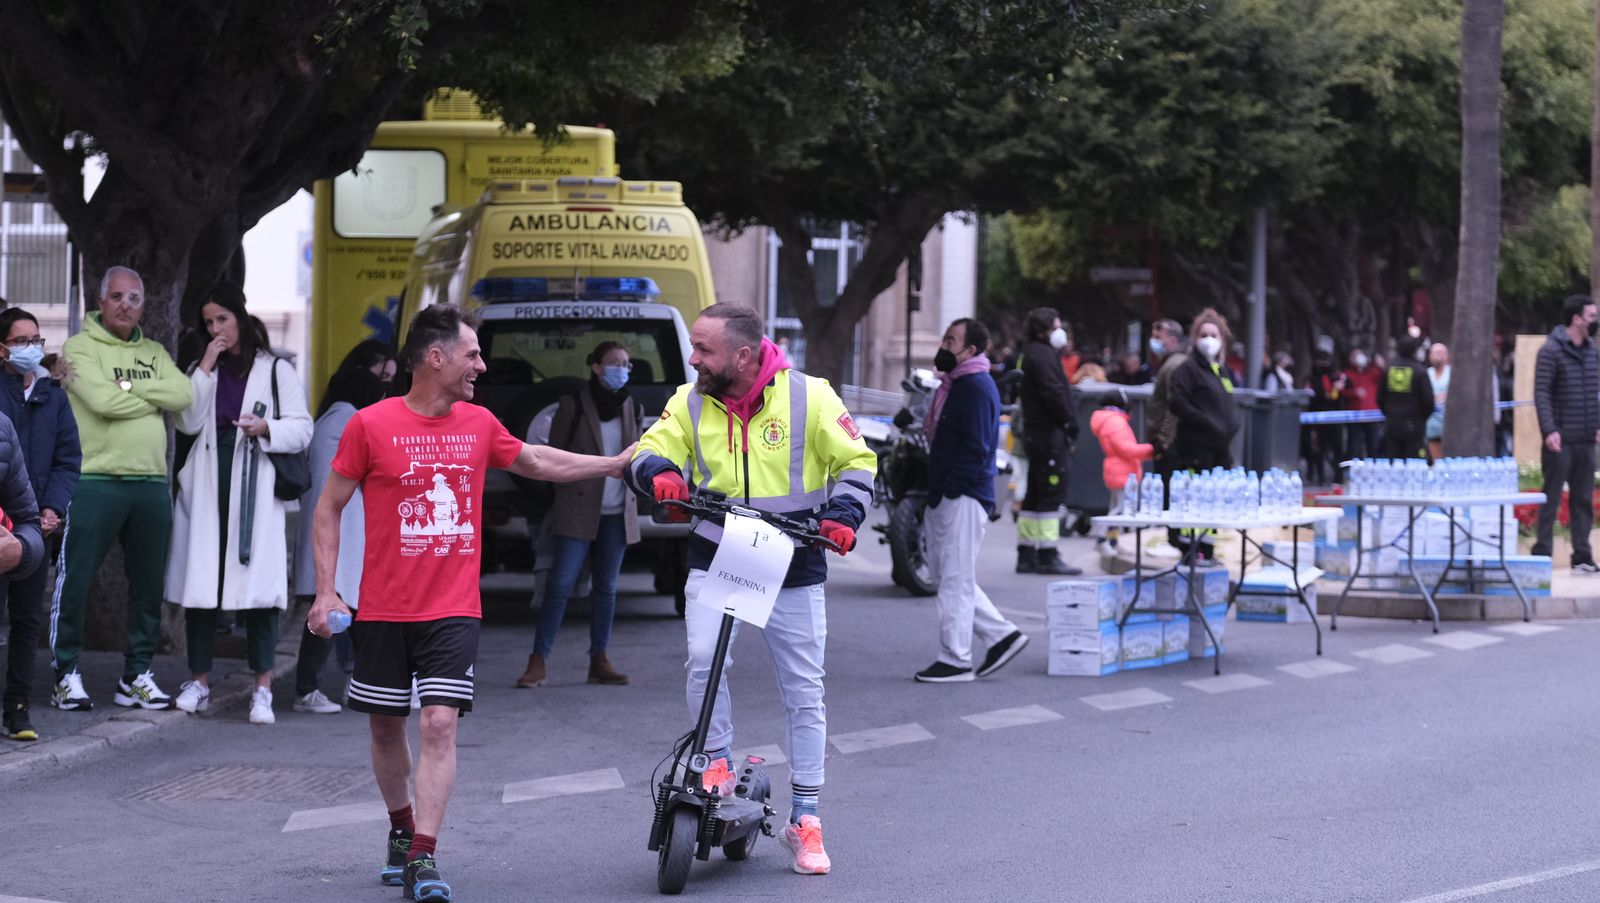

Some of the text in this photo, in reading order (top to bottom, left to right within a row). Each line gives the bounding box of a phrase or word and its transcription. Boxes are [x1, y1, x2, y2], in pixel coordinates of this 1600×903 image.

[509, 214, 672, 233] AMBULANCIA
[492, 242, 690, 262] SOPORTE VITAL AVANZADO
[611, 306, 645, 318] CIVIL
[760, 417, 788, 429] BOMBEROS
[400, 434, 477, 445] CARRERA BOMBEROS
[445, 444, 472, 453] CIUDAD
[718, 570, 767, 595] FEMENINA
